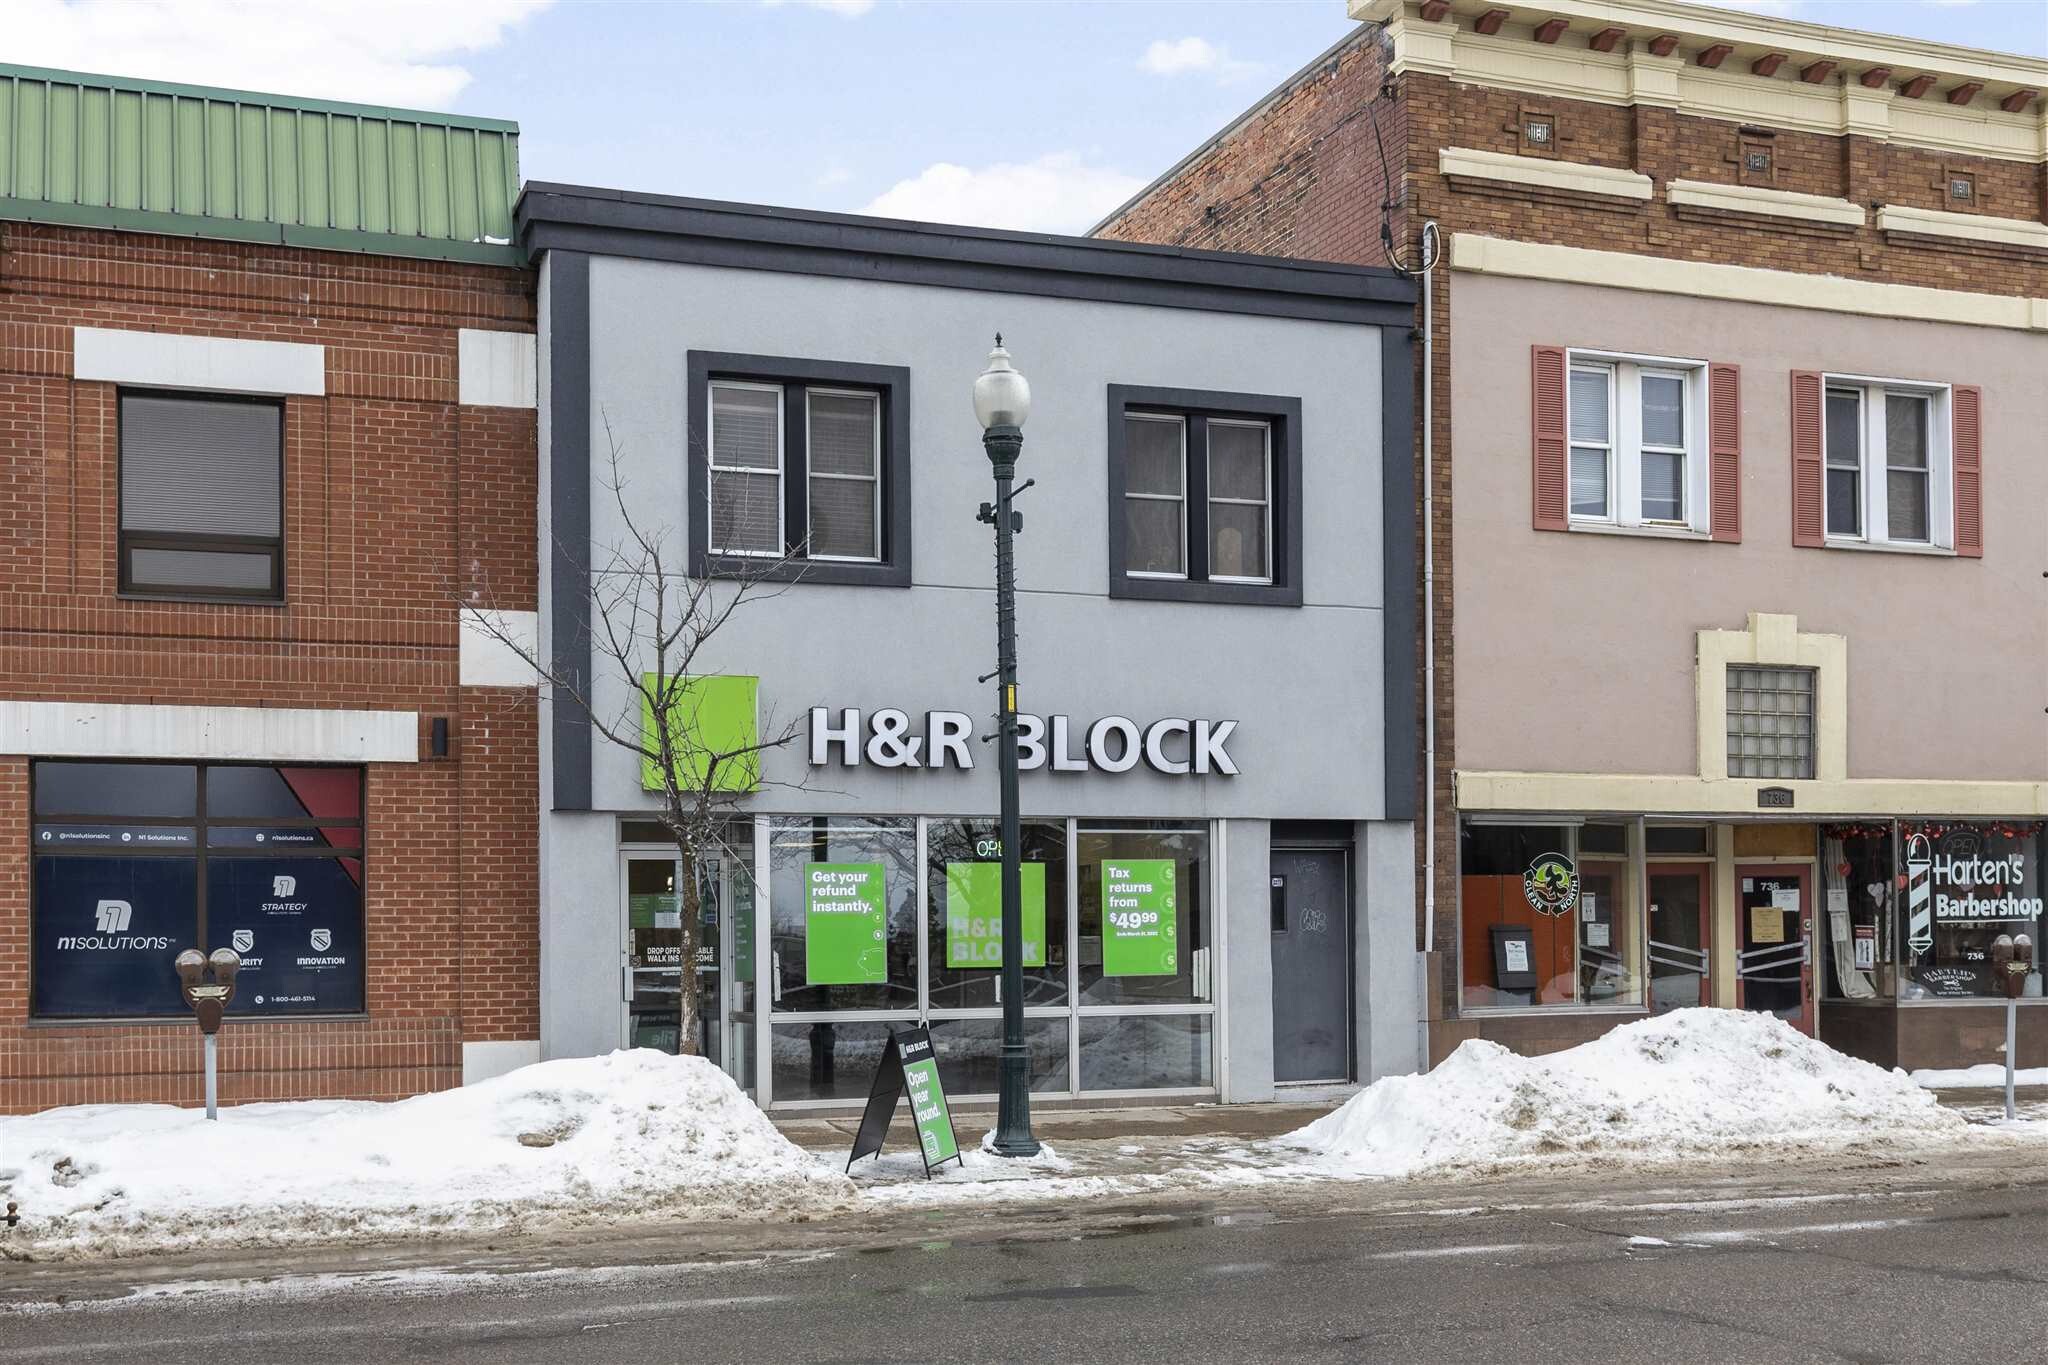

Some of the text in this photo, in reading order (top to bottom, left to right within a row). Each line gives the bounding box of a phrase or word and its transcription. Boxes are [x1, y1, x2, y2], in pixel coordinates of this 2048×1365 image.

[808, 706, 1240, 776] H&R BLOCK
[1109, 867, 1130, 878] Tax
[1933, 854, 2024, 885] Harten's
[812, 871, 868, 884] Get your
[812, 884, 856, 896] refund
[1109, 883, 1152, 893] returns
[1760, 882, 1780, 892] 736
[1109, 896, 1138, 907] from
[1525, 880, 1543, 910] CLEAN
[1560, 880, 1578, 911] NORTH
[261, 903, 308, 911] STRATEGY
[812, 900, 872, 913] instantly.
[1936, 891, 2043, 921] Barbershop
[953, 942, 1038, 961] BLOK
[1967, 952, 1984, 960] 736
[240, 958, 263, 966] URITY
[914, 1040, 929, 1052] BLOCK
[908, 1071, 928, 1088] Open
[912, 1090, 929, 1107] year
[917, 1102, 941, 1122] round.
